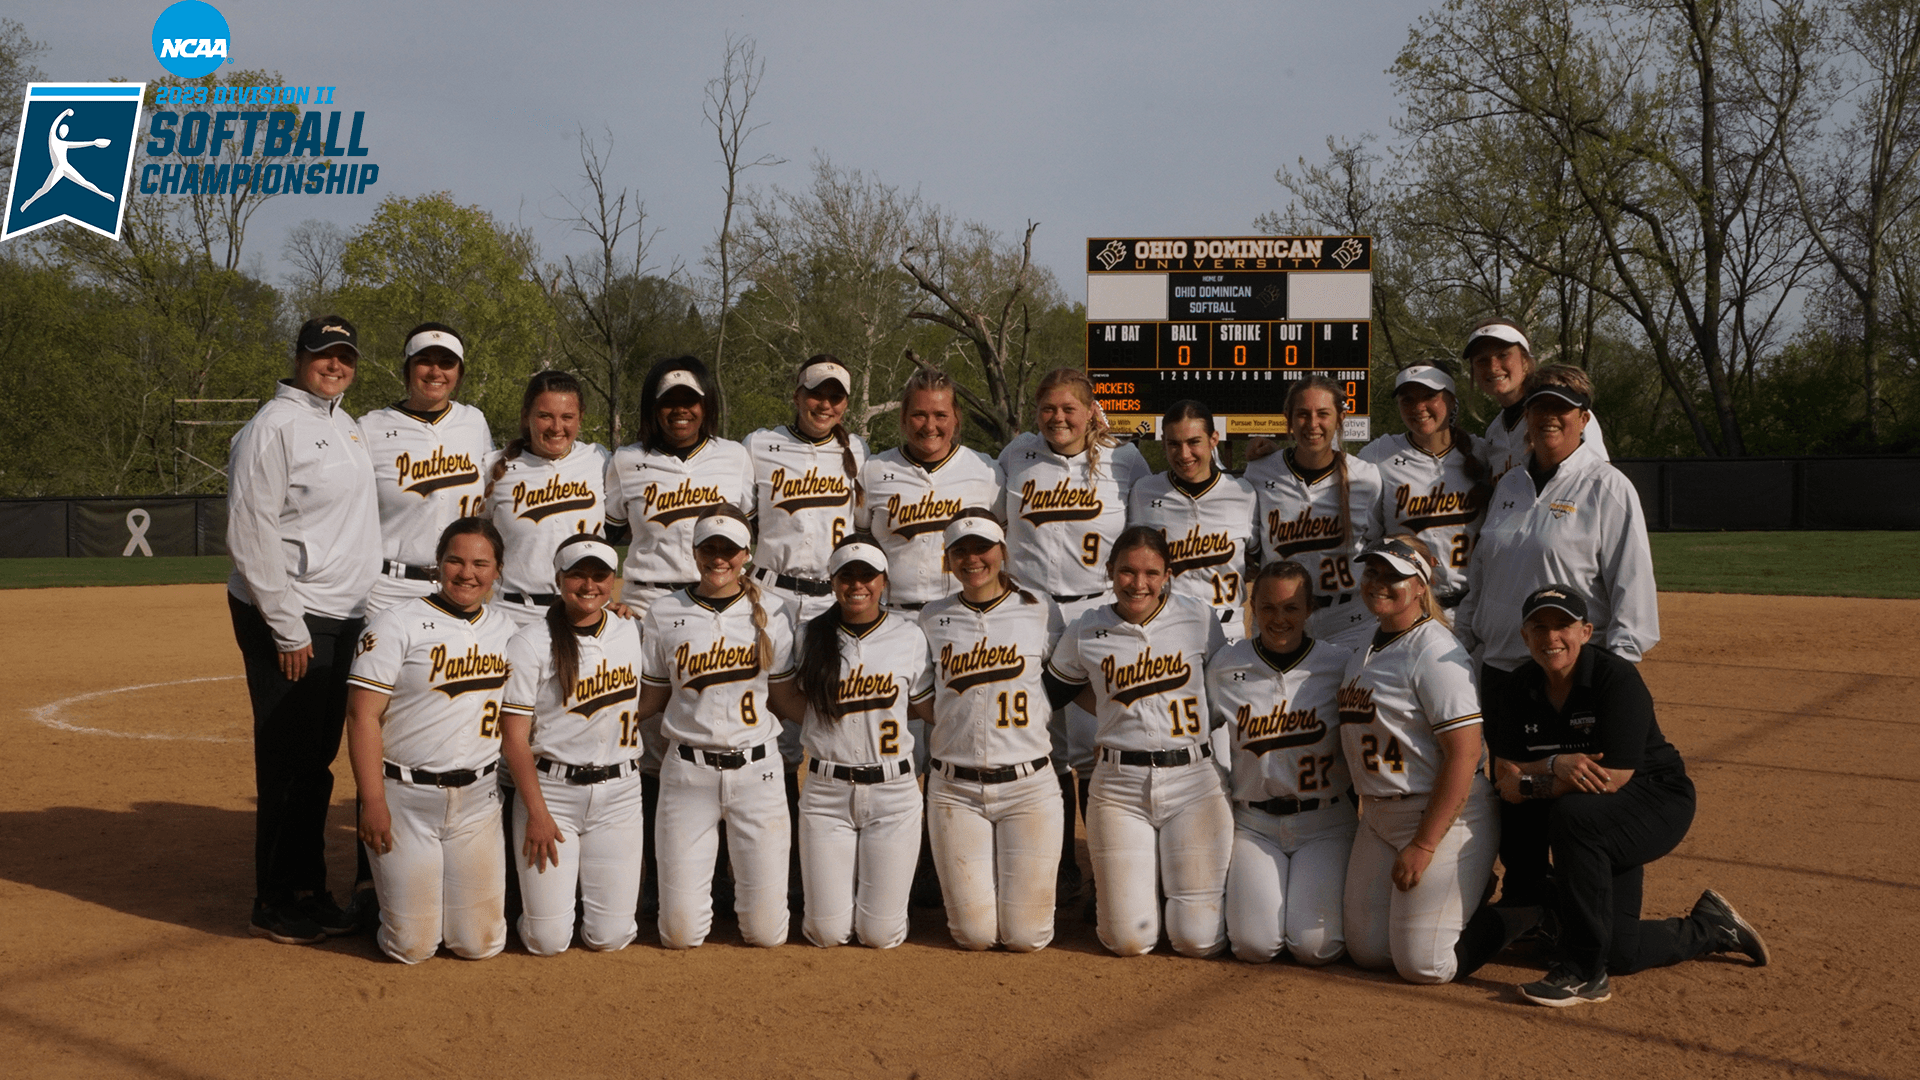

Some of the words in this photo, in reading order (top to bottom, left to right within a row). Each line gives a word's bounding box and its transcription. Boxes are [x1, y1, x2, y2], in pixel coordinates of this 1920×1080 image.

[1134, 240, 1188, 260] OHIO
[1193, 239, 1323, 259] DOMINICAN
[1135, 259, 1322, 269] UNIVERSITY
[1175, 286, 1196, 298] OHIO
[1199, 286, 1252, 298] DOMINICAN
[1189, 301, 1236, 313] SOFTBALL
[1104, 325, 1117, 341] AT
[1121, 325, 1140, 341] BAT
[1171, 324, 1197, 341] BALL
[1220, 324, 1261, 341] STRIKE
[1280, 324, 1303, 341] OUT
[1323, 324, 1332, 340] H
[1352, 324, 1358, 340] E
[1178, 345, 1190, 366] 0
[1234, 345, 1246, 366] 0
[1285, 345, 1297, 366] 0
[1092, 382, 1135, 394] JACKETS
[1160, 371, 1164, 380] 1
[1171, 371, 1176, 380] 2
[1183, 371, 1188, 380] 3
[1194, 371, 1200, 380] 4
[1206, 371, 1211, 380] 5
[1218, 371, 1223, 380] 6
[1230, 371, 1235, 380] 7
[1241, 371, 1247, 380] 8
[1253, 371, 1259, 380] 9
[1264, 371, 1272, 380] 10
[1283, 370, 1302, 380] RUNS
[1337, 370, 1365, 380] ERRORS
[1346, 381, 1356, 397] 0
[1099, 399, 1141, 411] ANTHERS
[1231, 419, 1252, 427] Pursue
[1253, 419, 1267, 427] Your
[1343, 419, 1366, 428] ative
[1344, 428, 1366, 438] plays
[396, 444, 475, 487] Panthers
[512, 473, 591, 514] Panthers
[643, 477, 721, 516] Panthers
[770, 466, 846, 501] Panthers
[1019, 477, 1098, 514] Panthers
[887, 490, 962, 528] Panthers
[1268, 506, 1341, 545] Panthers
[831, 516, 846, 550] 6
[1081, 531, 1100, 566] 9
[1162, 524, 1230, 561] anthers
[1211, 572, 1239, 606] 13
[1320, 555, 1355, 592] 28
[428, 643, 504, 683] Panthers
[675, 635, 756, 680] Panthers
[941, 636, 1019, 680] Panthers
[1100, 645, 1185, 694] Panthers
[575, 658, 635, 703] anthers
[479, 699, 500, 739] 2
[739, 690, 759, 726] 8
[996, 690, 1029, 728] 19
[1168, 696, 1201, 738] 15
[1236, 699, 1319, 741] Panthers
[879, 719, 899, 755] 2
[1361, 733, 1404, 774] 24
[1298, 753, 1334, 792] 27
